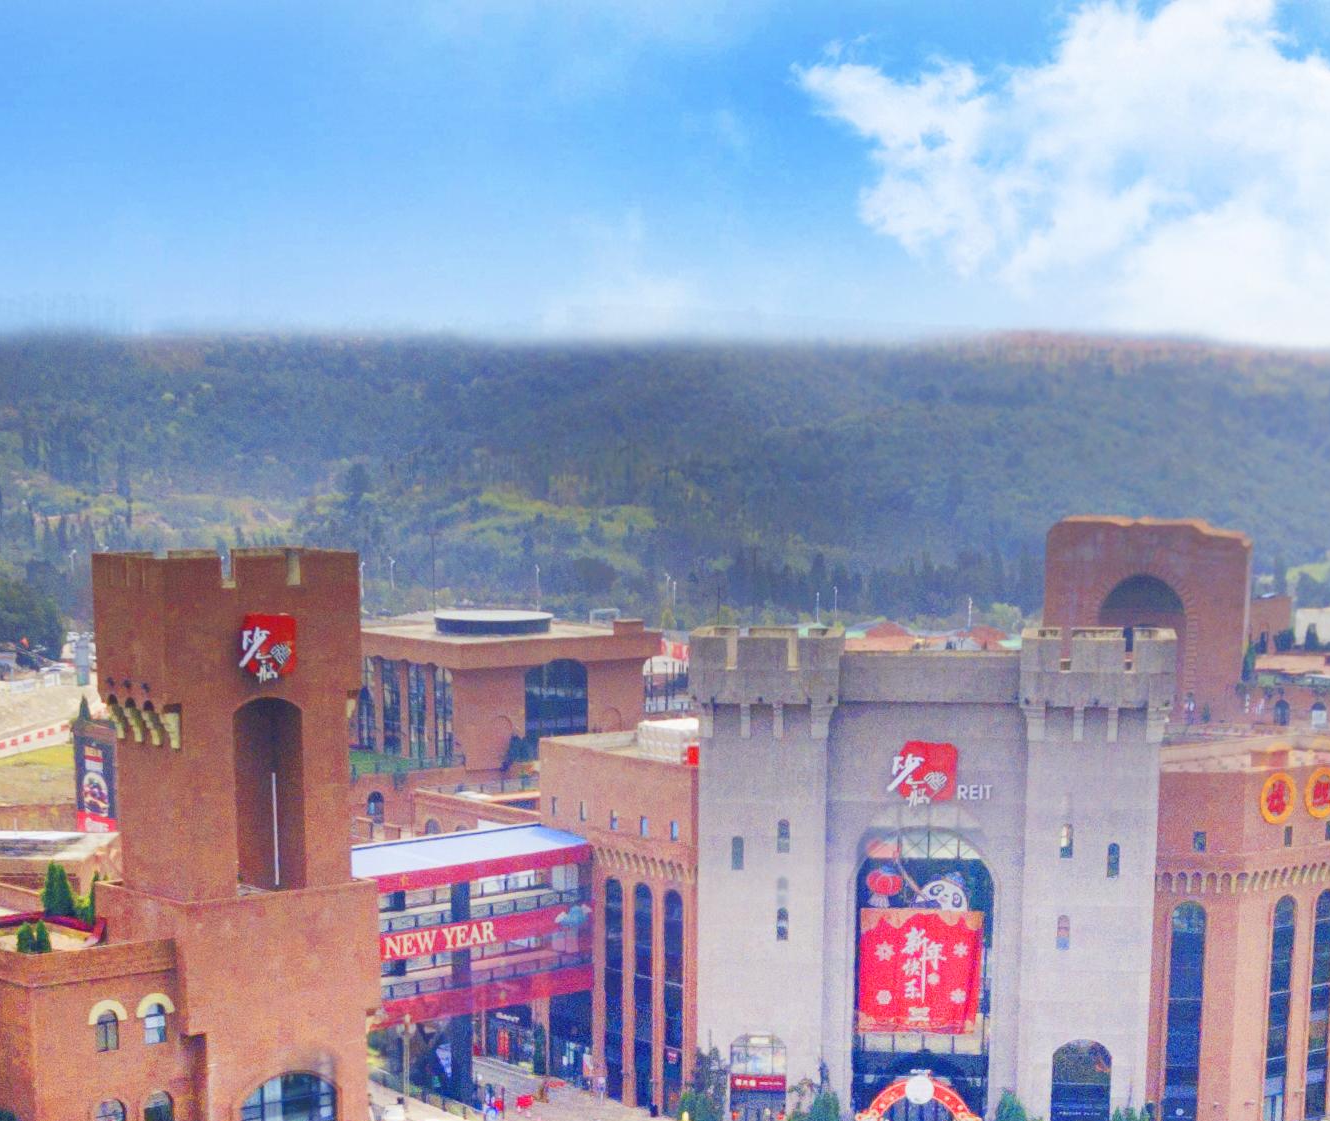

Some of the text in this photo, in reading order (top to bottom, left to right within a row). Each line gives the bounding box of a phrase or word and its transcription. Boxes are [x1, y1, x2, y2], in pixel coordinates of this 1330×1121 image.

[957, 785, 992, 800] REIT
[384, 921, 498, 959] NEW YEAR
